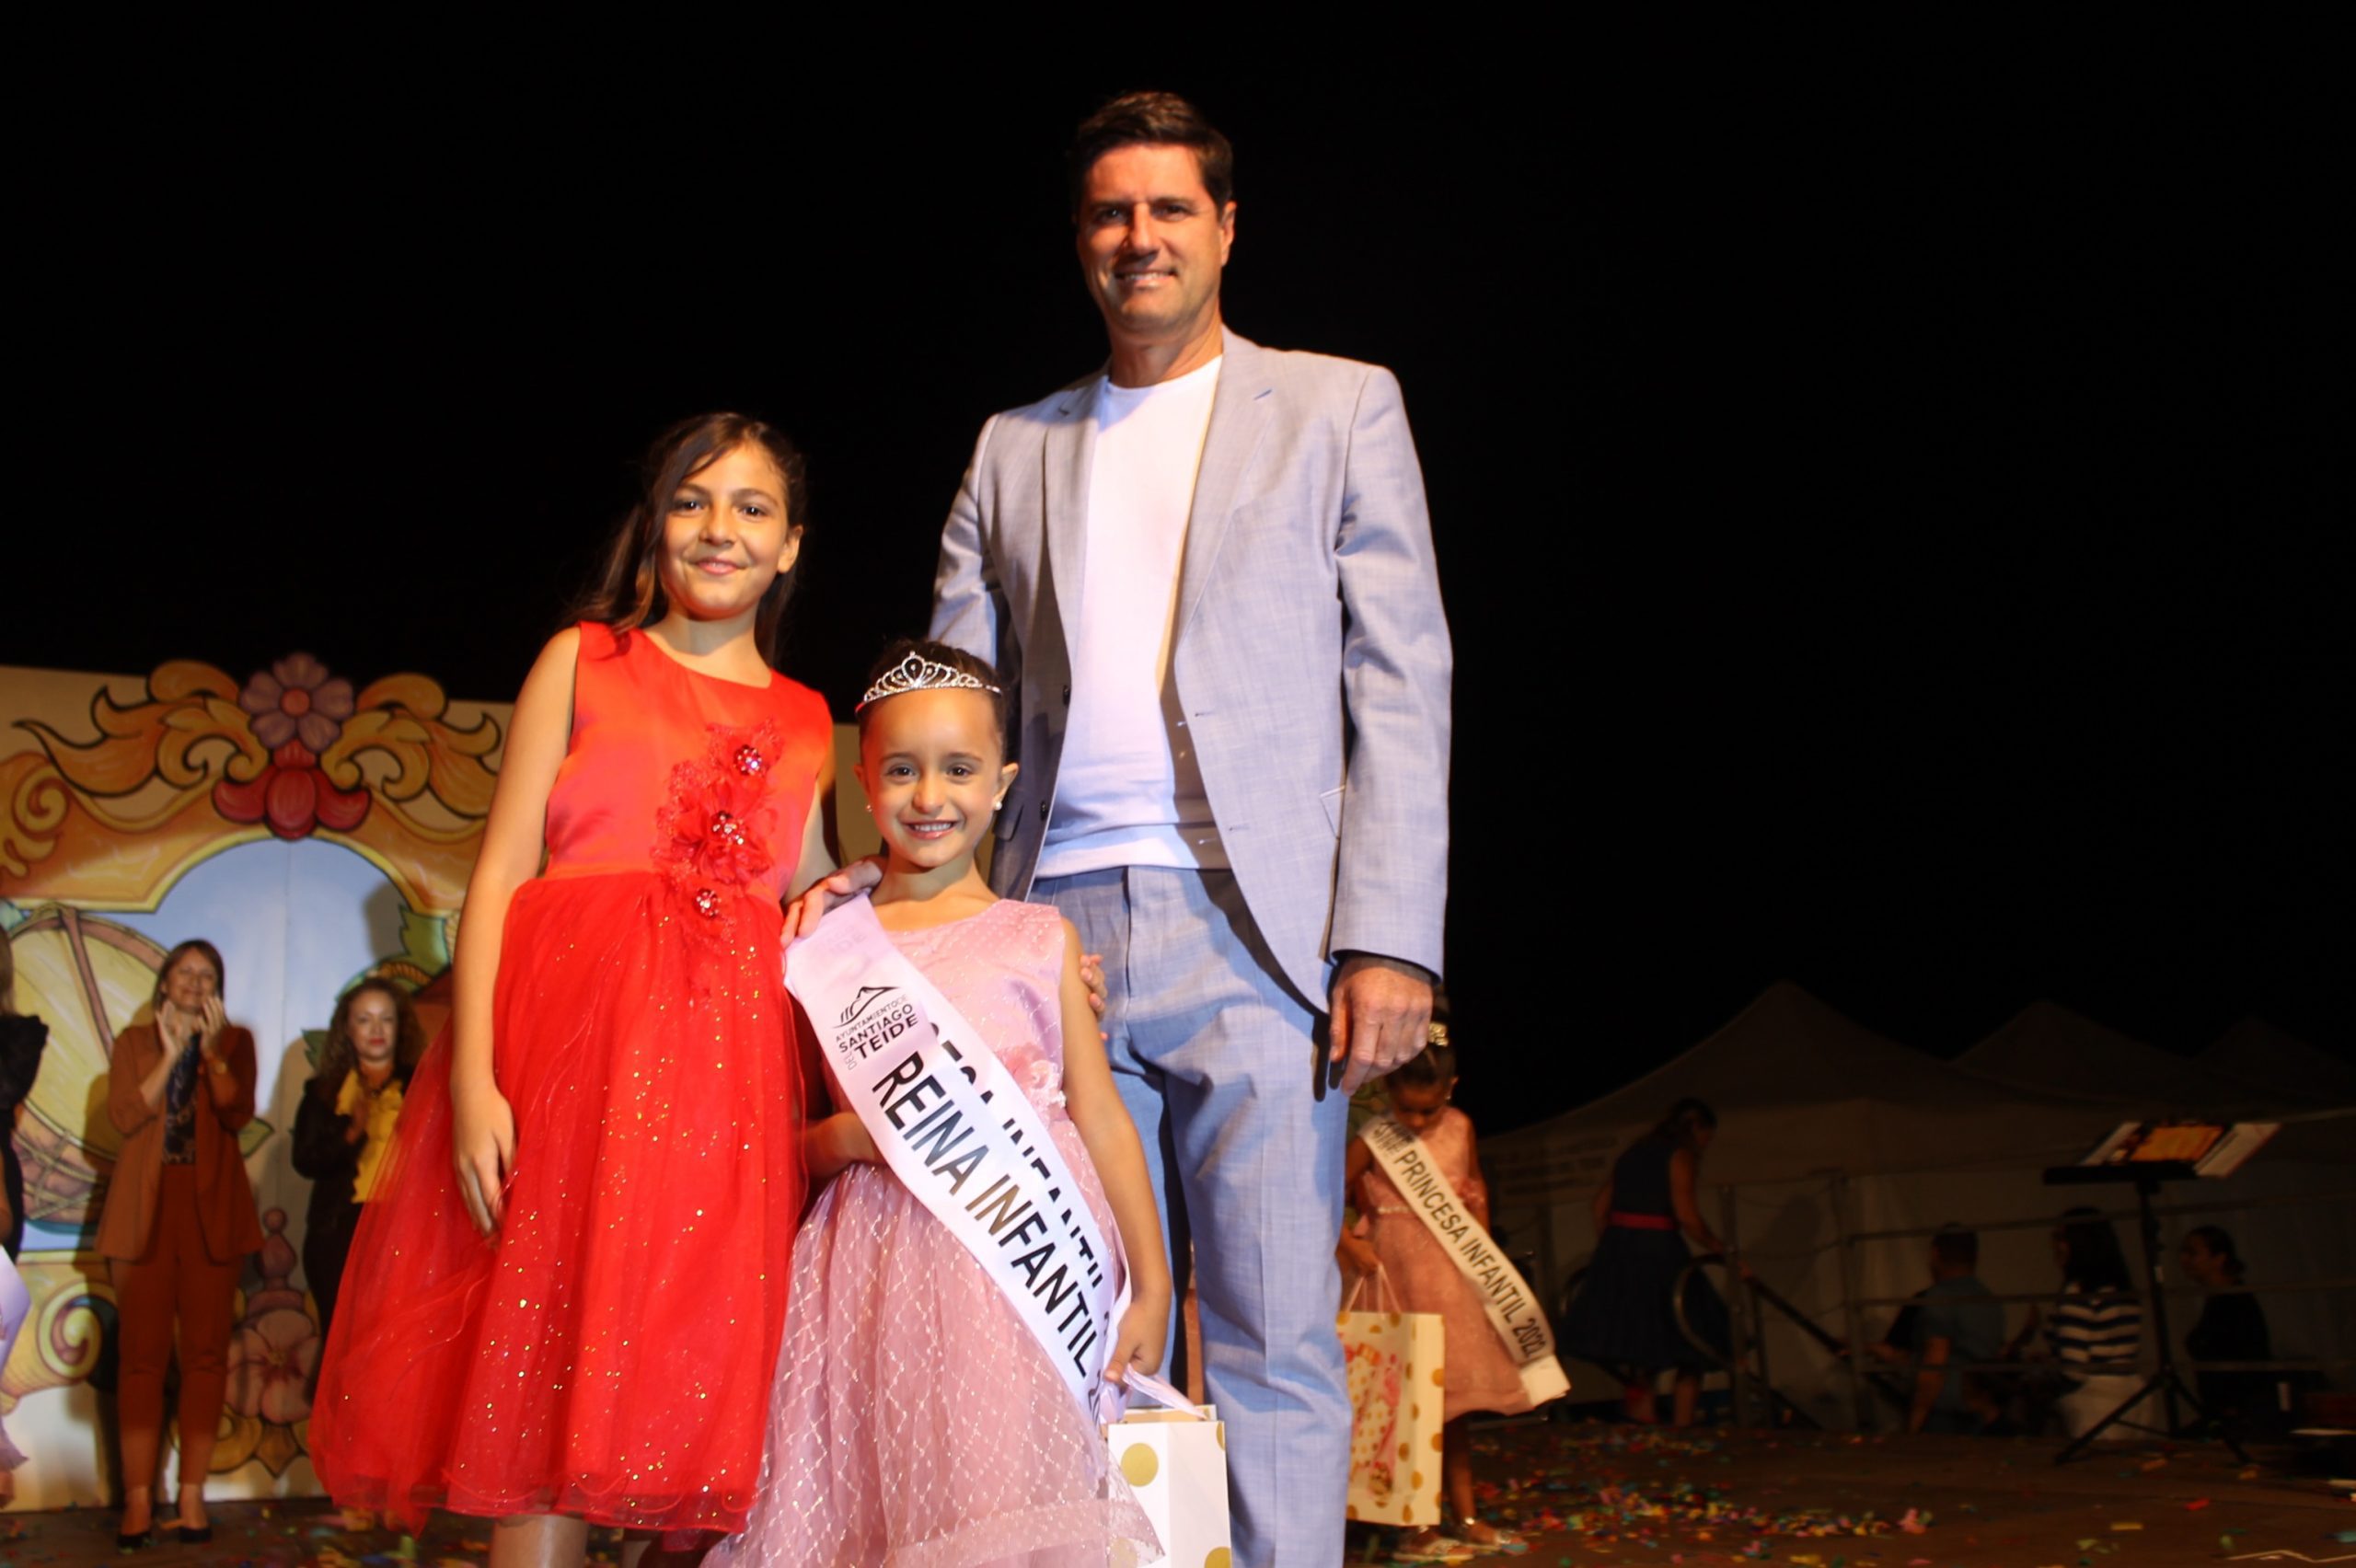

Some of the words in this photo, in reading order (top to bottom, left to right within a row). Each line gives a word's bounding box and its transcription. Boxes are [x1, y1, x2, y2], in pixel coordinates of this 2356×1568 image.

[836, 1000, 898, 1042] AYUNTAMIENTO
[838, 1003, 913, 1053] SANTIAGO
[854, 1013, 919, 1059] TEIDE
[872, 1050, 989, 1195] REINA
[965, 1174, 1098, 1378] INFANTIL
[1393, 1149, 1470, 1243] PRINCESA
[1460, 1238, 1526, 1325] INFANTIL
